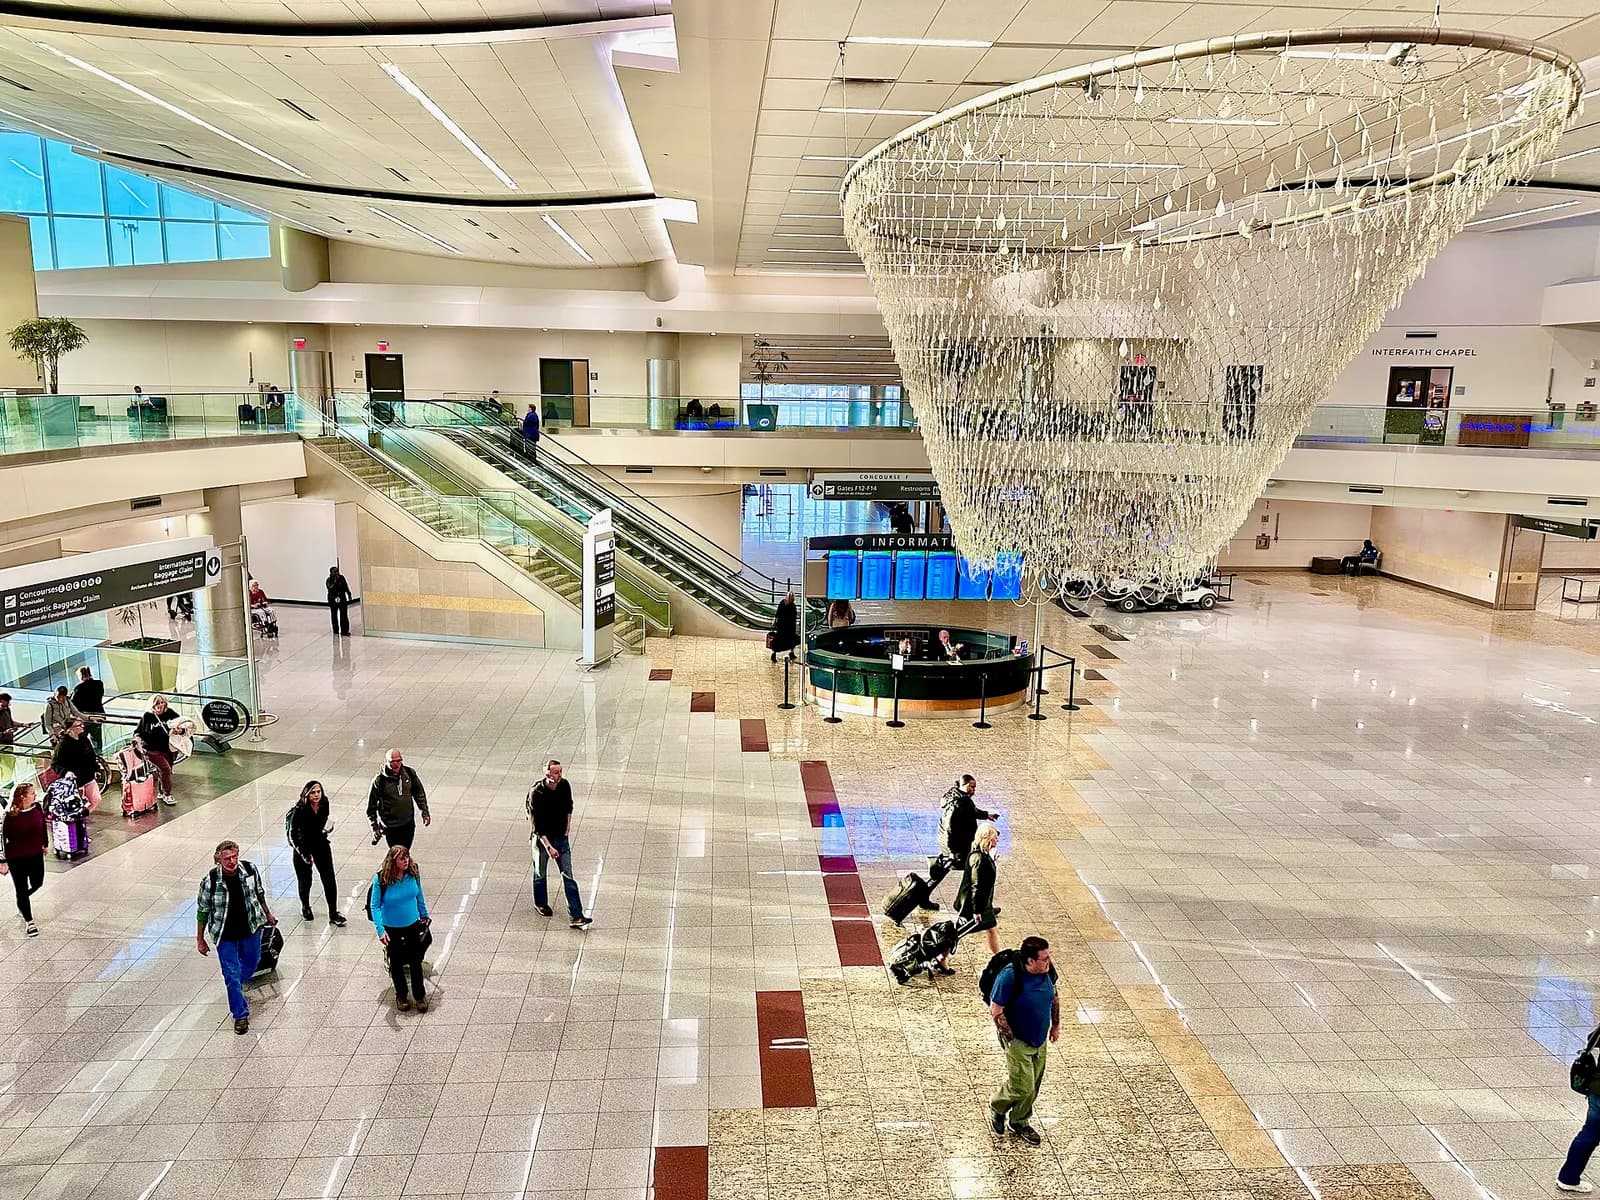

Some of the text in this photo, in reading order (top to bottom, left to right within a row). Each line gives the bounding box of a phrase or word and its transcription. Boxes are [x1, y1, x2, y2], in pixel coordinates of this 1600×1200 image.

[1372, 348, 1477, 356] INTERFAITH CHAPEL
[159, 557, 194, 571] International
[153, 565, 194, 580] Baggage Claim
[19, 586, 58, 600] Concourses
[19, 594, 101, 618] Domestic Baggage Claim
